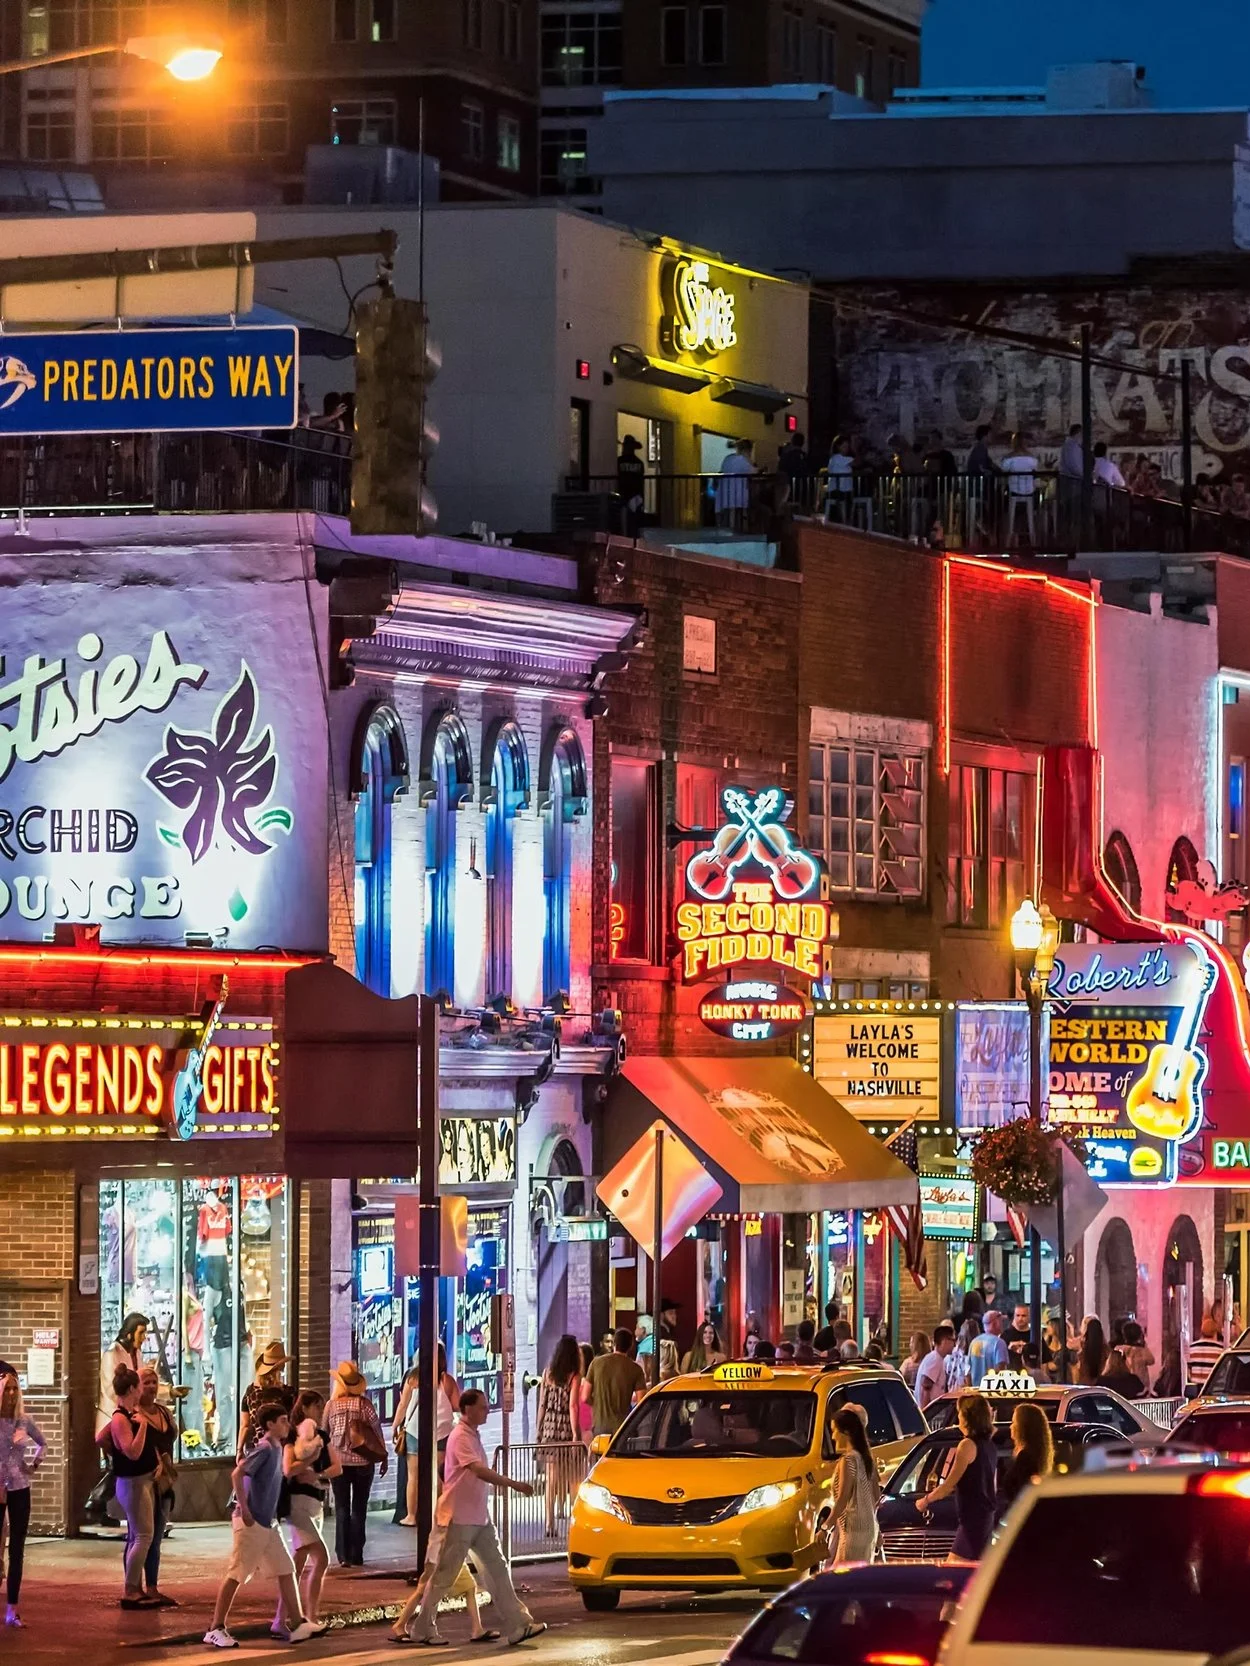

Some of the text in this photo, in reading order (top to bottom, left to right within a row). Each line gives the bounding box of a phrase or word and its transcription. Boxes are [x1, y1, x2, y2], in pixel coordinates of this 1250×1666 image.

[43, 354, 293, 402] PREDATORS WAY
[731, 882, 773, 902] THE
[677, 902, 827, 943] SECOND
[684, 934, 821, 978] FIDDLE
[725, 982, 778, 1000] MUSIC
[701, 1004, 803, 1020] HONKY TONK
[732, 1022, 771, 1040] CITY
[850, 1023, 915, 1041] LAYLA'S
[1050, 1018, 1168, 1041] ESTERN
[846, 1043, 919, 1059] WELCOME
[872, 1062, 889, 1077] TO
[1, 1043, 163, 1116] LEGENDS
[202, 1045, 275, 1115] GIFTS
[847, 1079, 922, 1096] NASHVILLE
[1050, 1071, 1111, 1092] OME
[1115, 1071, 1133, 1098] of
[1092, 1126, 1137, 1140] Heaven
[35, 1331, 57, 1340] HELP
[722, 1366, 762, 1380] YELLOW
[983, 1378, 1030, 1391] TAXI
